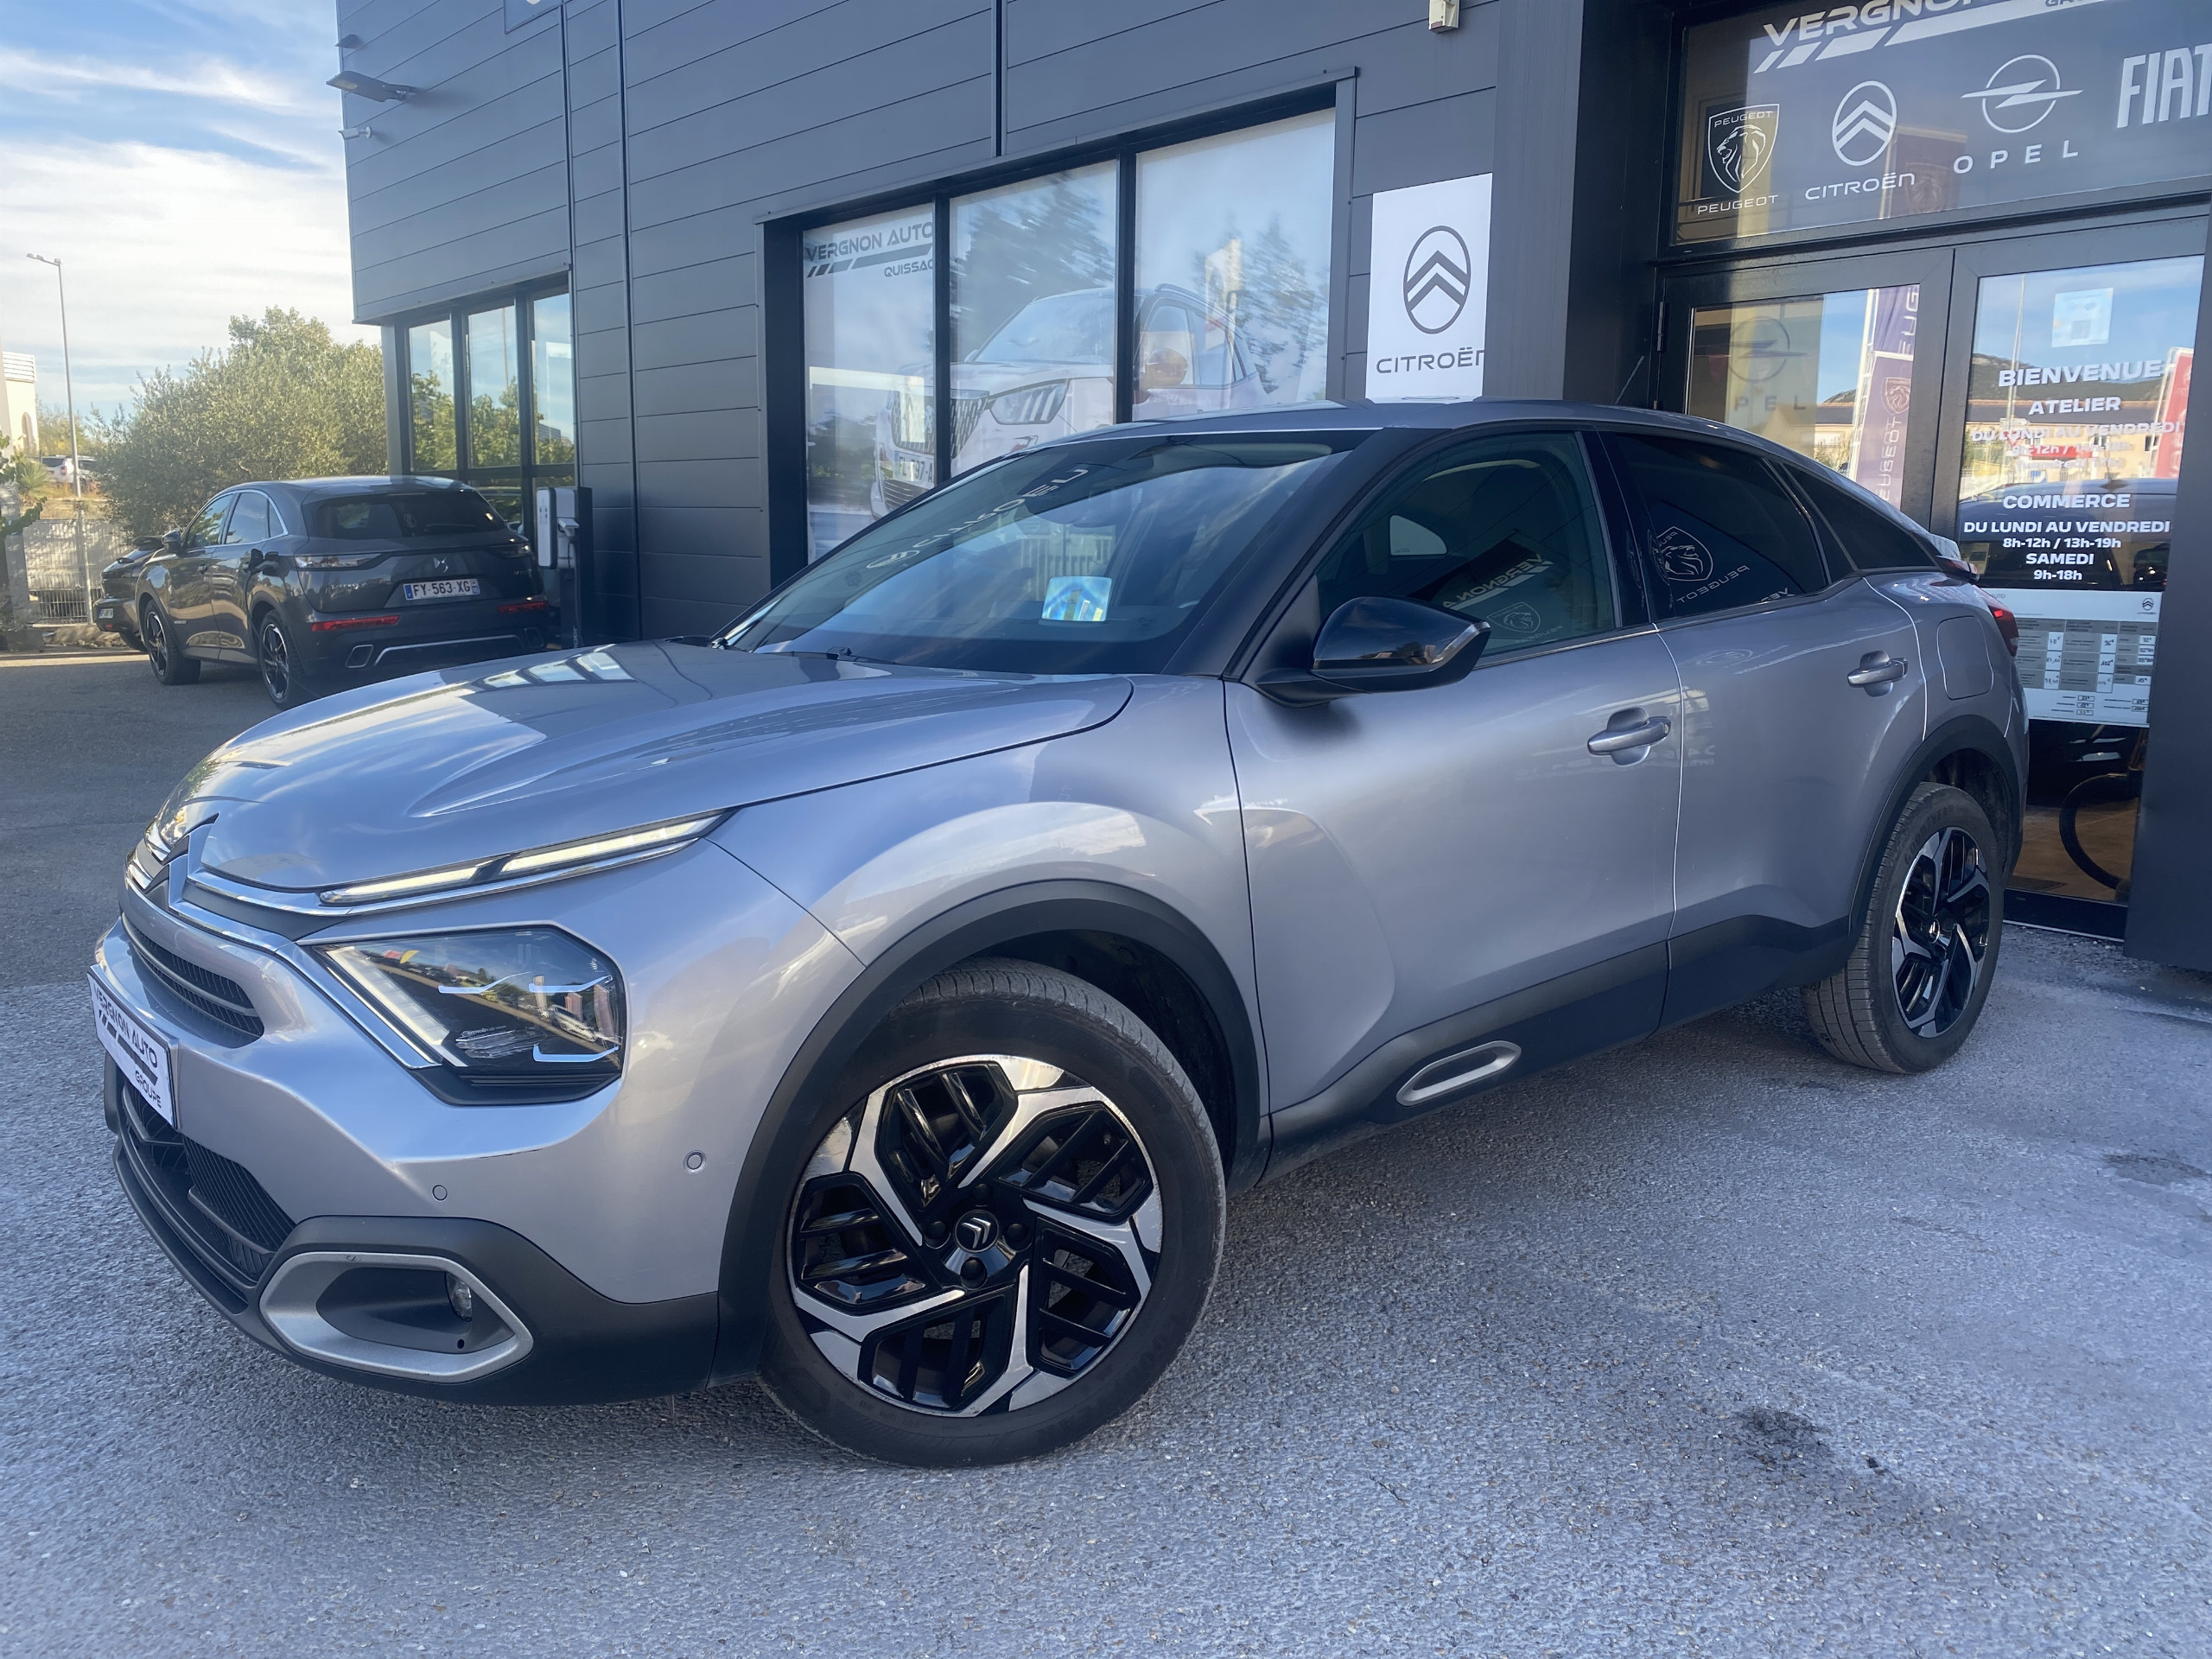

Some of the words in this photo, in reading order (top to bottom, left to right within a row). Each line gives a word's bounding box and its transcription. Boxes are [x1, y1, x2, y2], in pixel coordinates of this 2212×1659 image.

[2117, 43, 2212, 128] FIAT
[1714, 111, 1774, 128] PEUGEOT
[1953, 140, 2079, 174] OPEL
[1697, 194, 1779, 215] PEUGEOT
[805, 232, 882, 262] VERGNON
[887, 221, 933, 246] AUTO
[1999, 359, 2163, 387] BIENVENUE
[2028, 396, 2121, 415] ATELIER
[2085, 420, 2182, 436] VENDREDI
[2003, 493, 2131, 509] COMMERCE
[1963, 521, 1988, 533] DU
[1991, 521, 2043, 533] LUNDI
[2044, 521, 2072, 533] AU
[2075, 521, 2171, 533] VENDREDI
[2002, 537, 2051, 548] 8h-12h
[2053, 537, 2062, 550] /
[2064, 537, 2122, 549] 13h-19h
[2025, 553, 2094, 565] SAMEDI
[2033, 569, 2083, 581] 9h-18h
[412, 581, 471, 597] FY-563-XG
[92, 982, 130, 1038] VERGNON
[131, 1028, 158, 1069] AUTO
[135, 1070, 162, 1109] GROUPE
